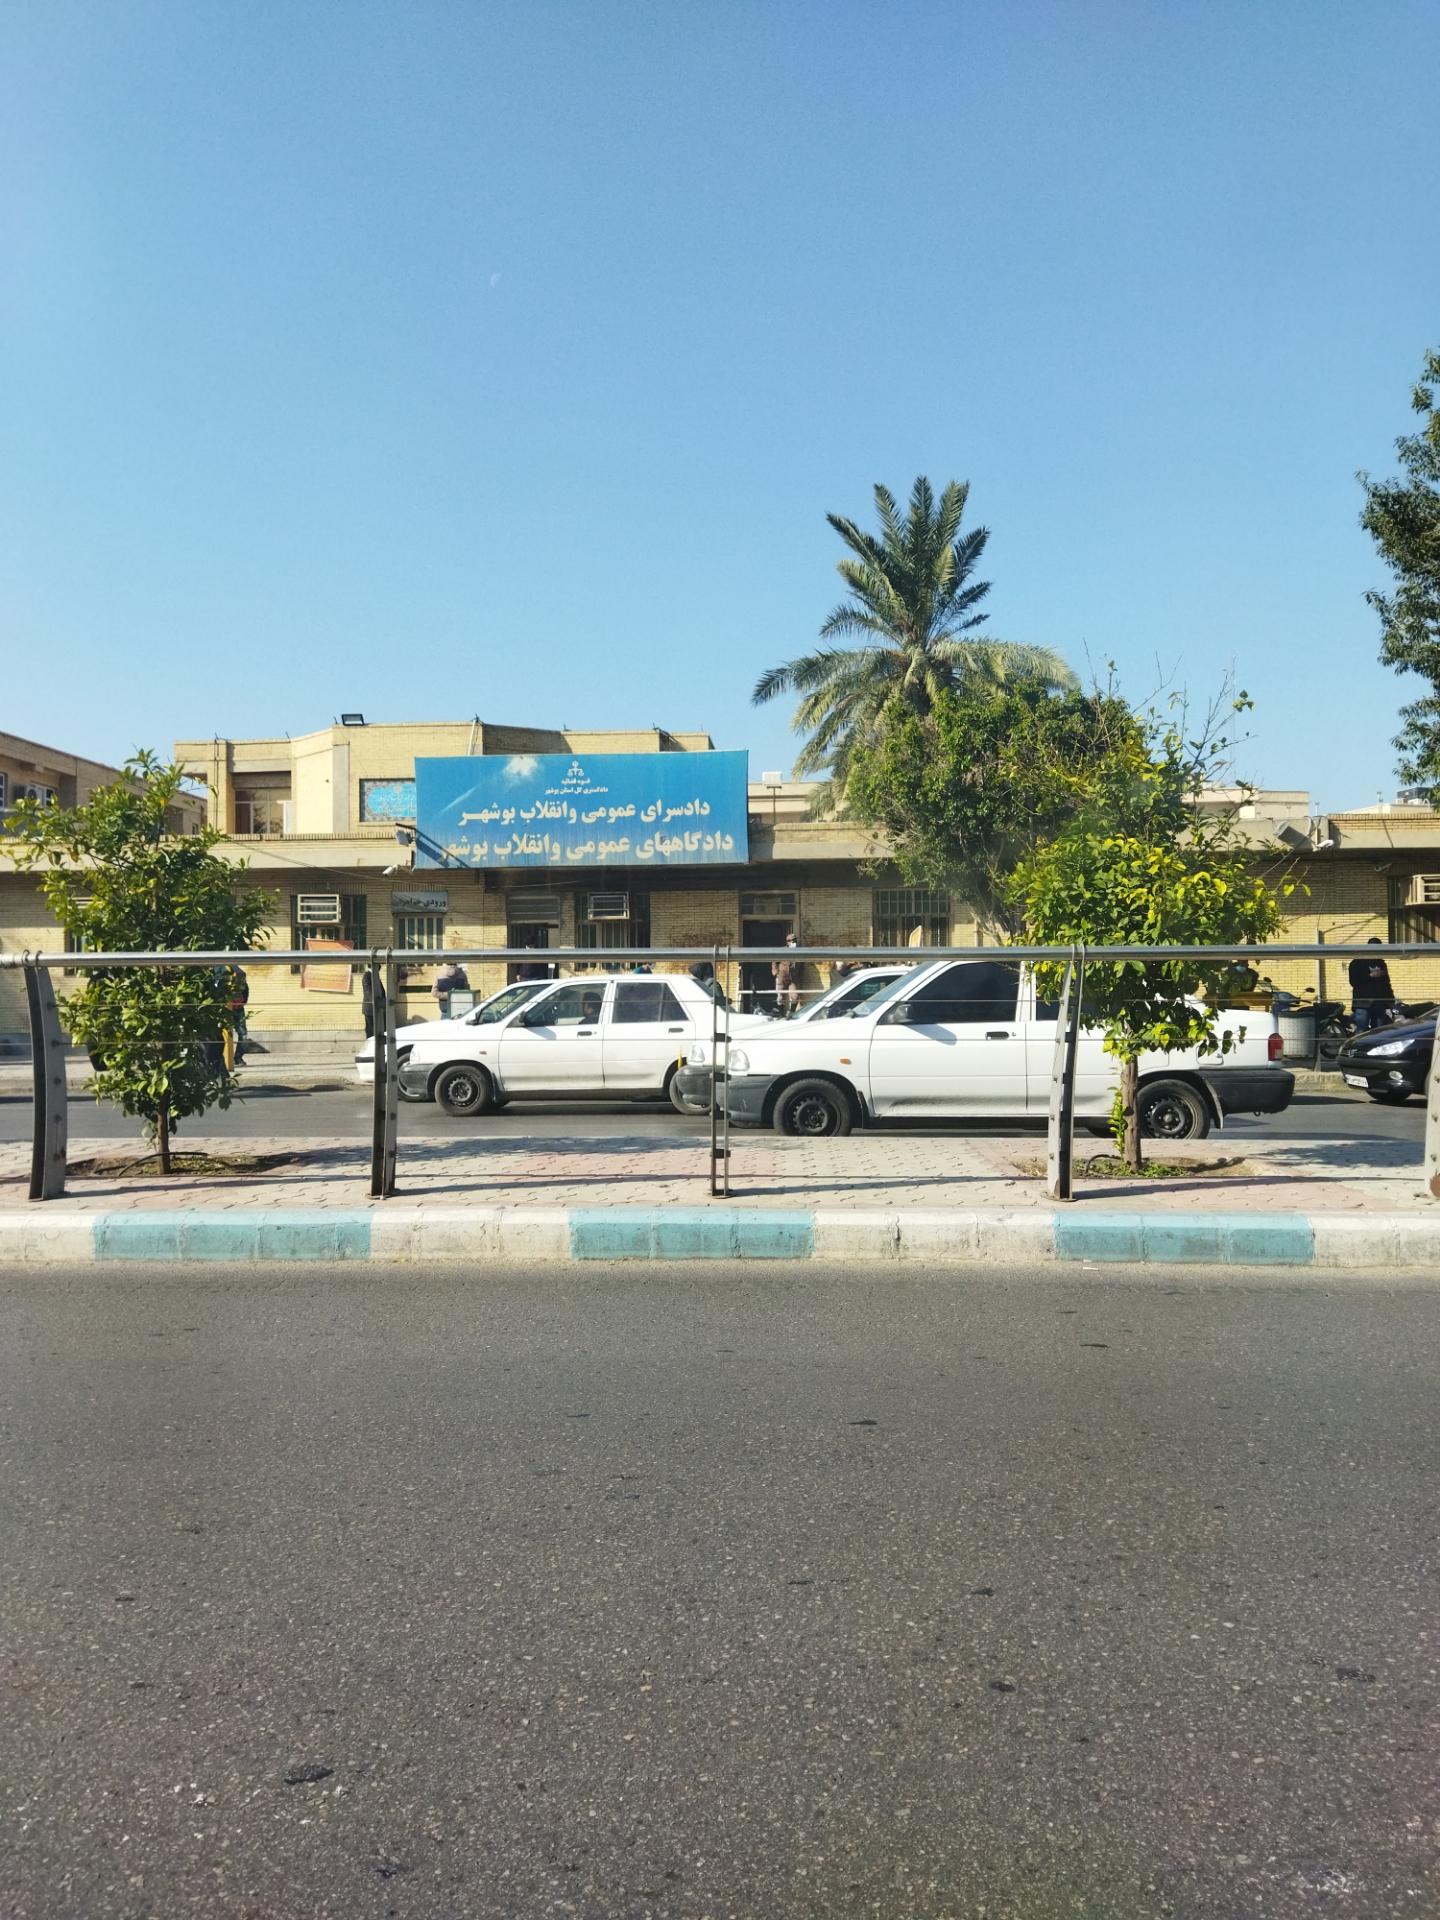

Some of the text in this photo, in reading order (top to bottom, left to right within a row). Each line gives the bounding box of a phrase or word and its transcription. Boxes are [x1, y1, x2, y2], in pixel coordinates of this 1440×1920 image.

[457, 801, 516, 826] بوشهر
[581, 803, 637, 824] عمومی
[640, 797, 711, 823] دادسرای
[566, 836, 631, 860] عمومی
[635, 829, 734, 859] دادگاههای
